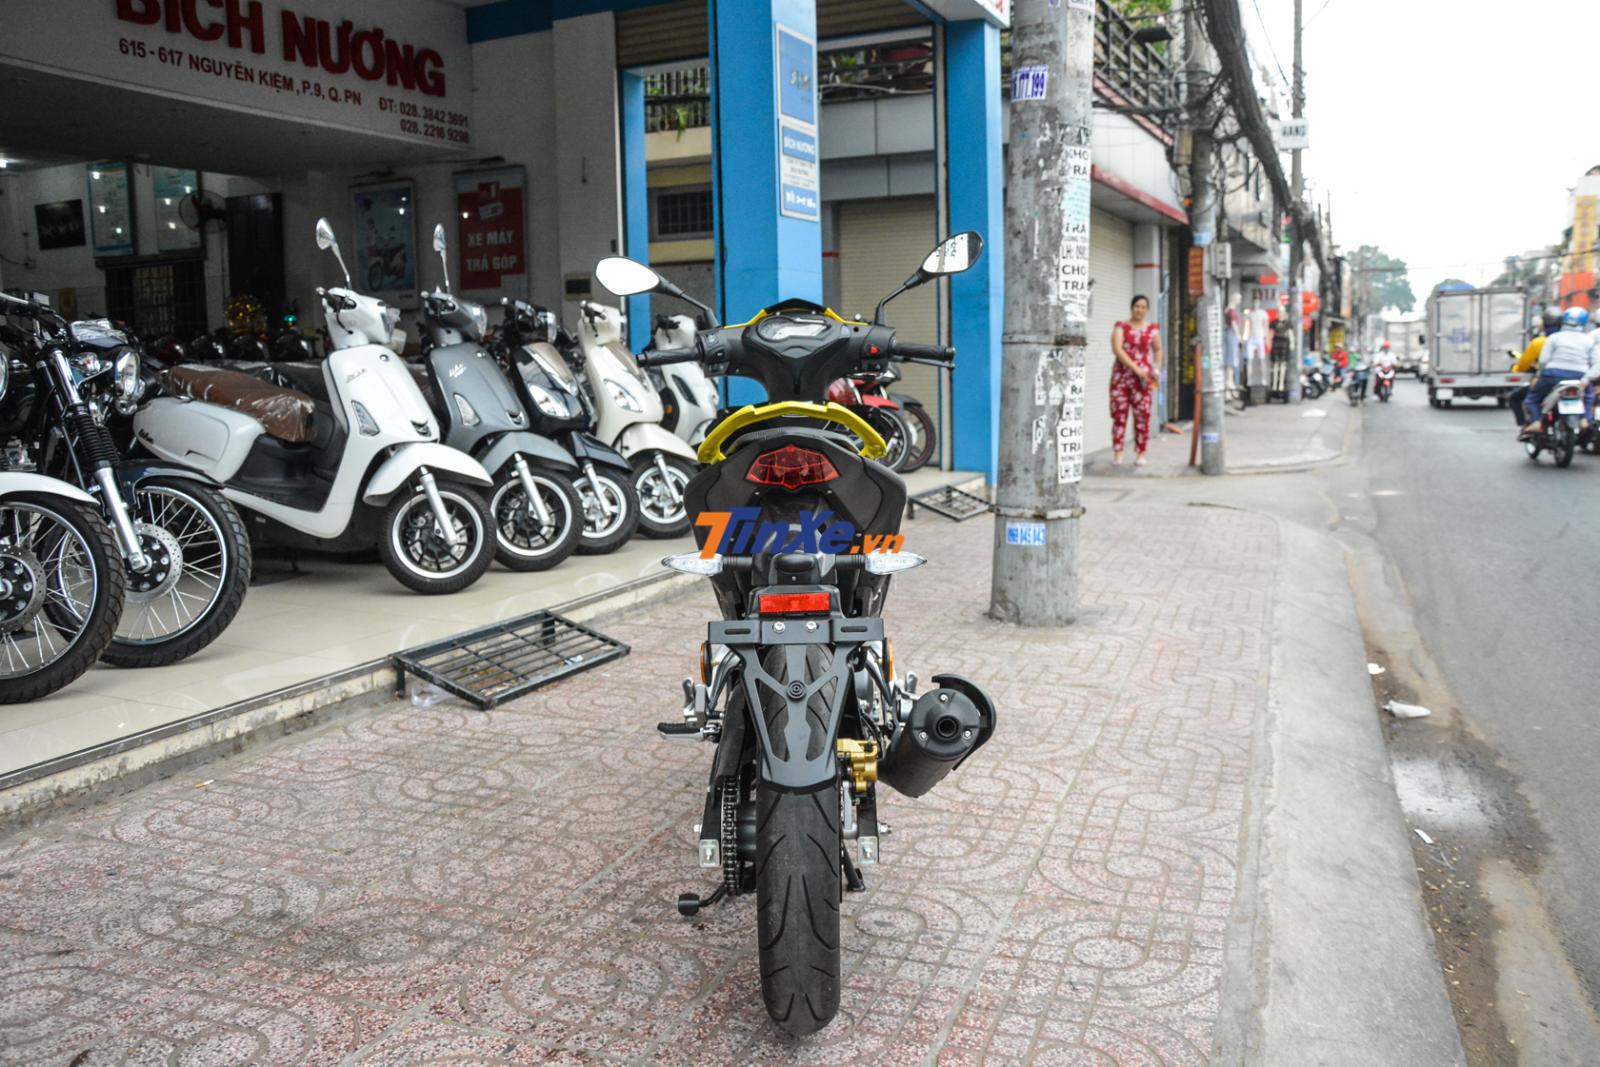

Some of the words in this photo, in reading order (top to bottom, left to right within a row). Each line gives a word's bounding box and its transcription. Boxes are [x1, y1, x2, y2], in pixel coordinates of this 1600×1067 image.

[119, 38, 146, 58] 615
[158, 47, 183, 66] 617
[281, 10, 446, 97] NƯƠNG
[467, 233, 482, 246] XE
[487, 228, 513, 245] MÁY
[492, 254, 517, 270] GÓP
